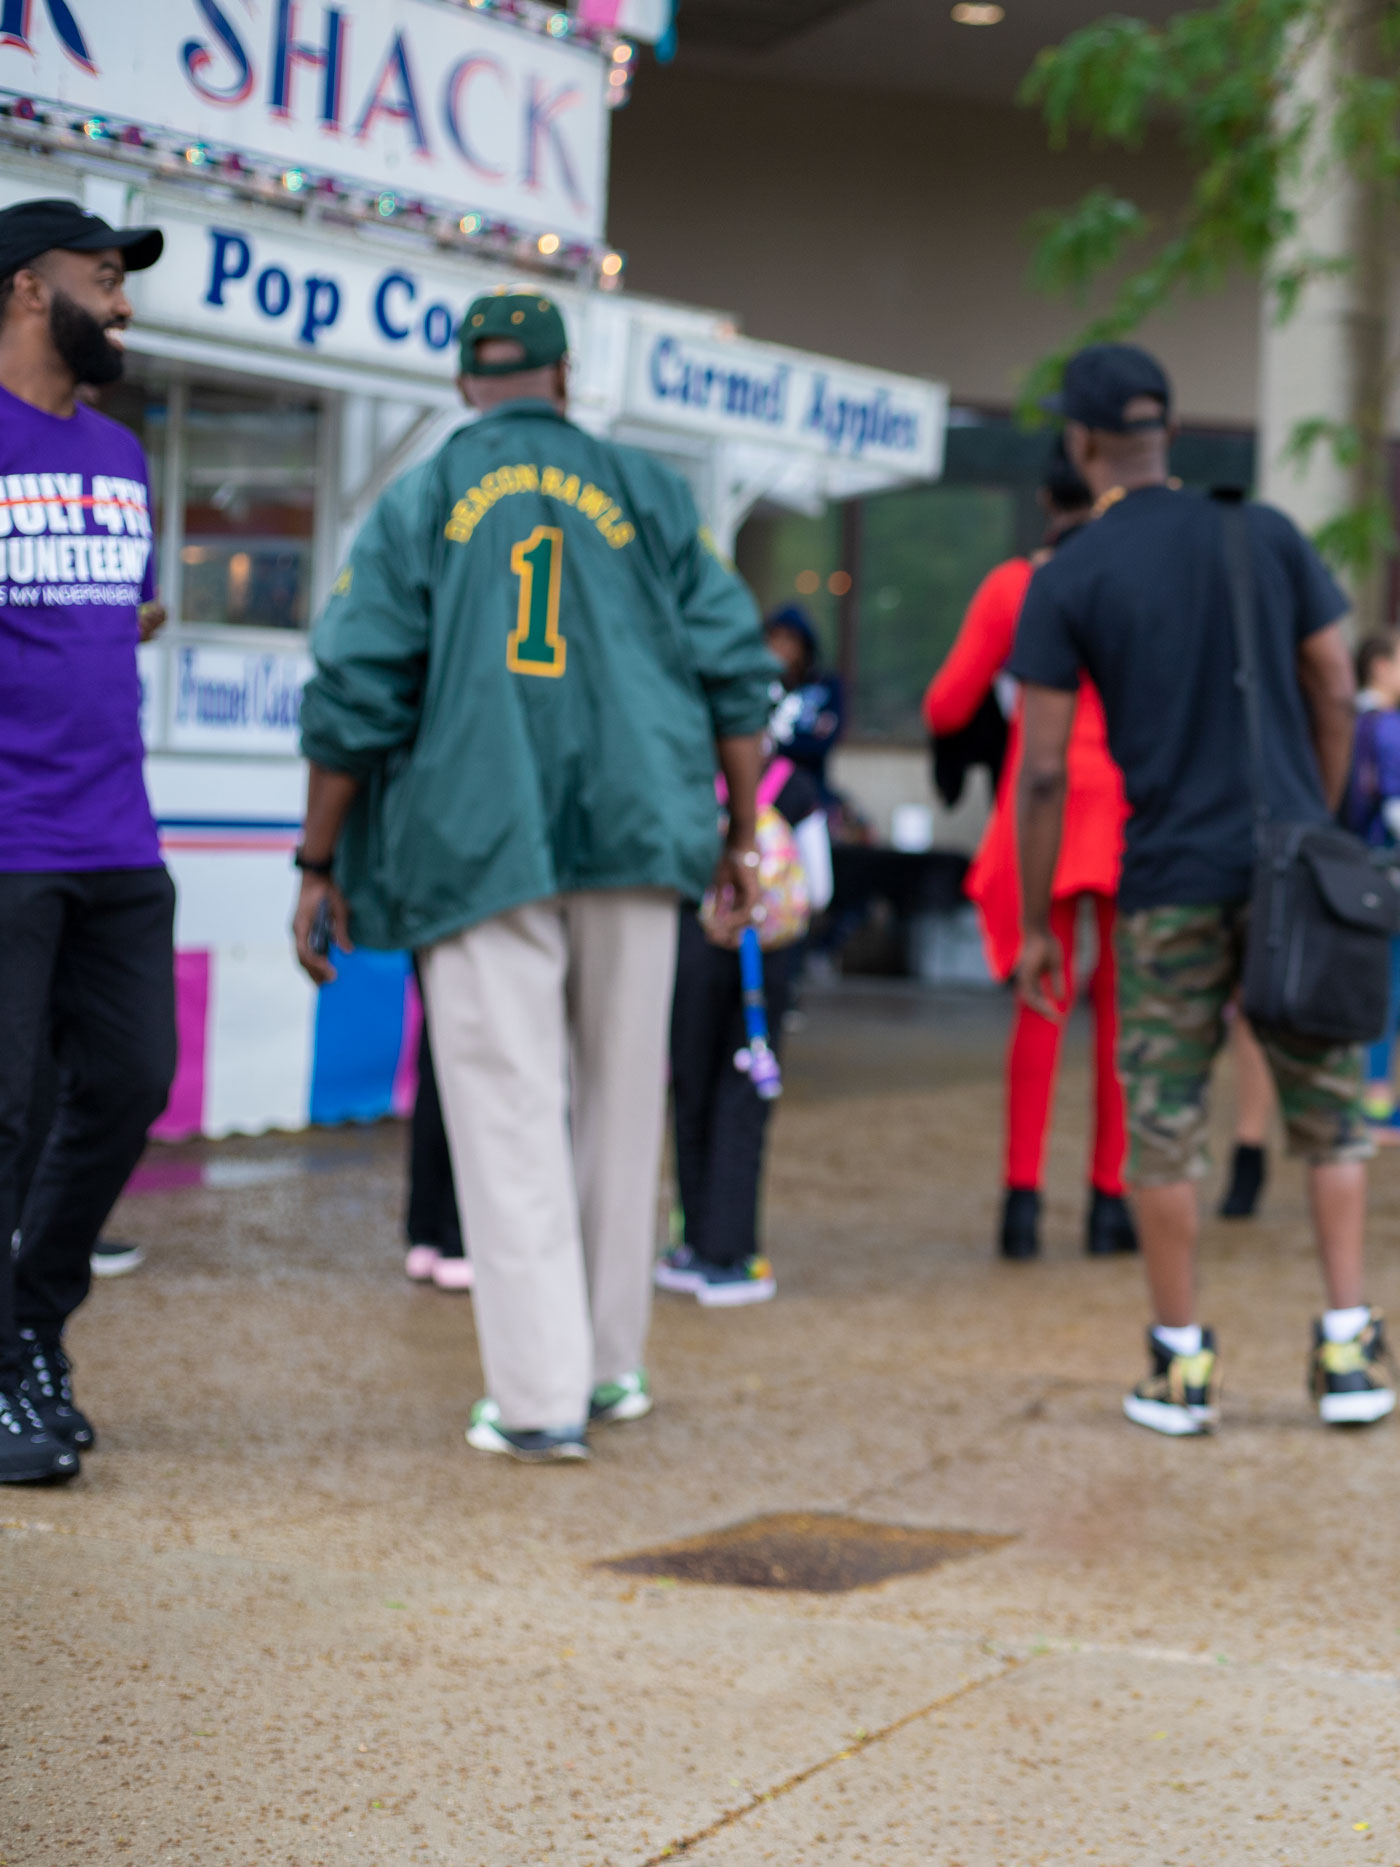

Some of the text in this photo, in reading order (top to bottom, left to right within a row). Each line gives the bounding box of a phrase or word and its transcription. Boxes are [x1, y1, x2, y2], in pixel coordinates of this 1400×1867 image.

[180, 0, 590, 215] SHACK
[204, 224, 341, 347] Pop
[506, 524, 567, 678] 1
